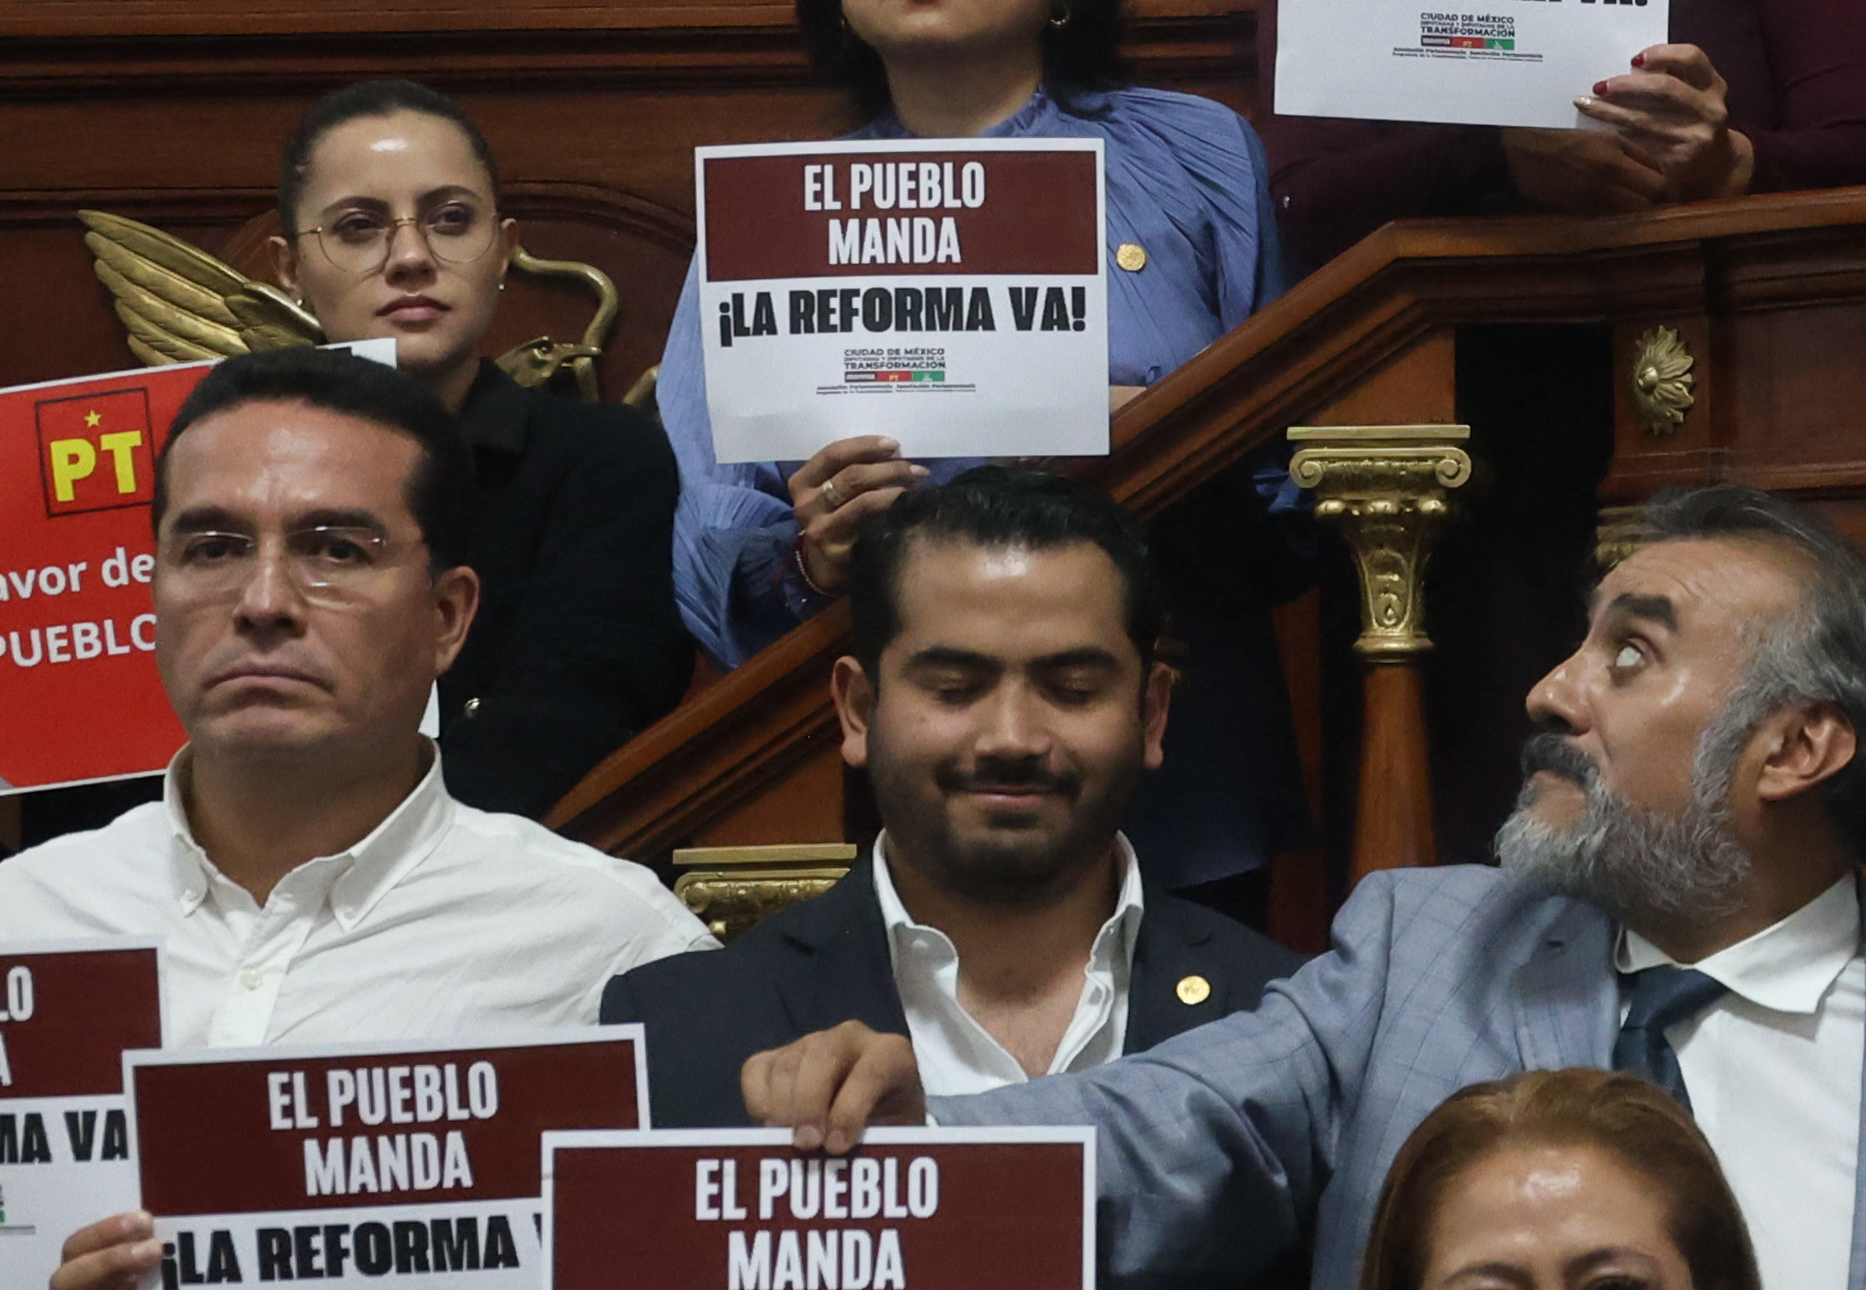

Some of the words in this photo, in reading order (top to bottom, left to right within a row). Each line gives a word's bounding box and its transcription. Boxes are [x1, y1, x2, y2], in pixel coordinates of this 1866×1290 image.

[1421, 13, 1458, 21] CIUDAD
[1477, 15, 1514, 24] MÉXICO
[1421, 27, 1515, 37] TRANSFORMACIÓN
[805, 165, 841, 210] EL
[851, 162, 984, 209] PUEBLO
[829, 217, 961, 264] MANDA
[719, 292, 777, 347] ¡LA
[789, 287, 995, 334] REFORMA
[1009, 287, 1085, 331] VA!
[844, 361, 945, 369] TRANSFORMACIÓN
[904, 347, 944, 355] MÉXICO
[50, 430, 142, 502] PT
[101, 547, 155, 587] de
[0, 614, 157, 667] UEBLO
[696, 1160, 746, 1220] EL
[757, 1158, 939, 1221] PUEBLO
[729, 1230, 904, 1290] MANDA
